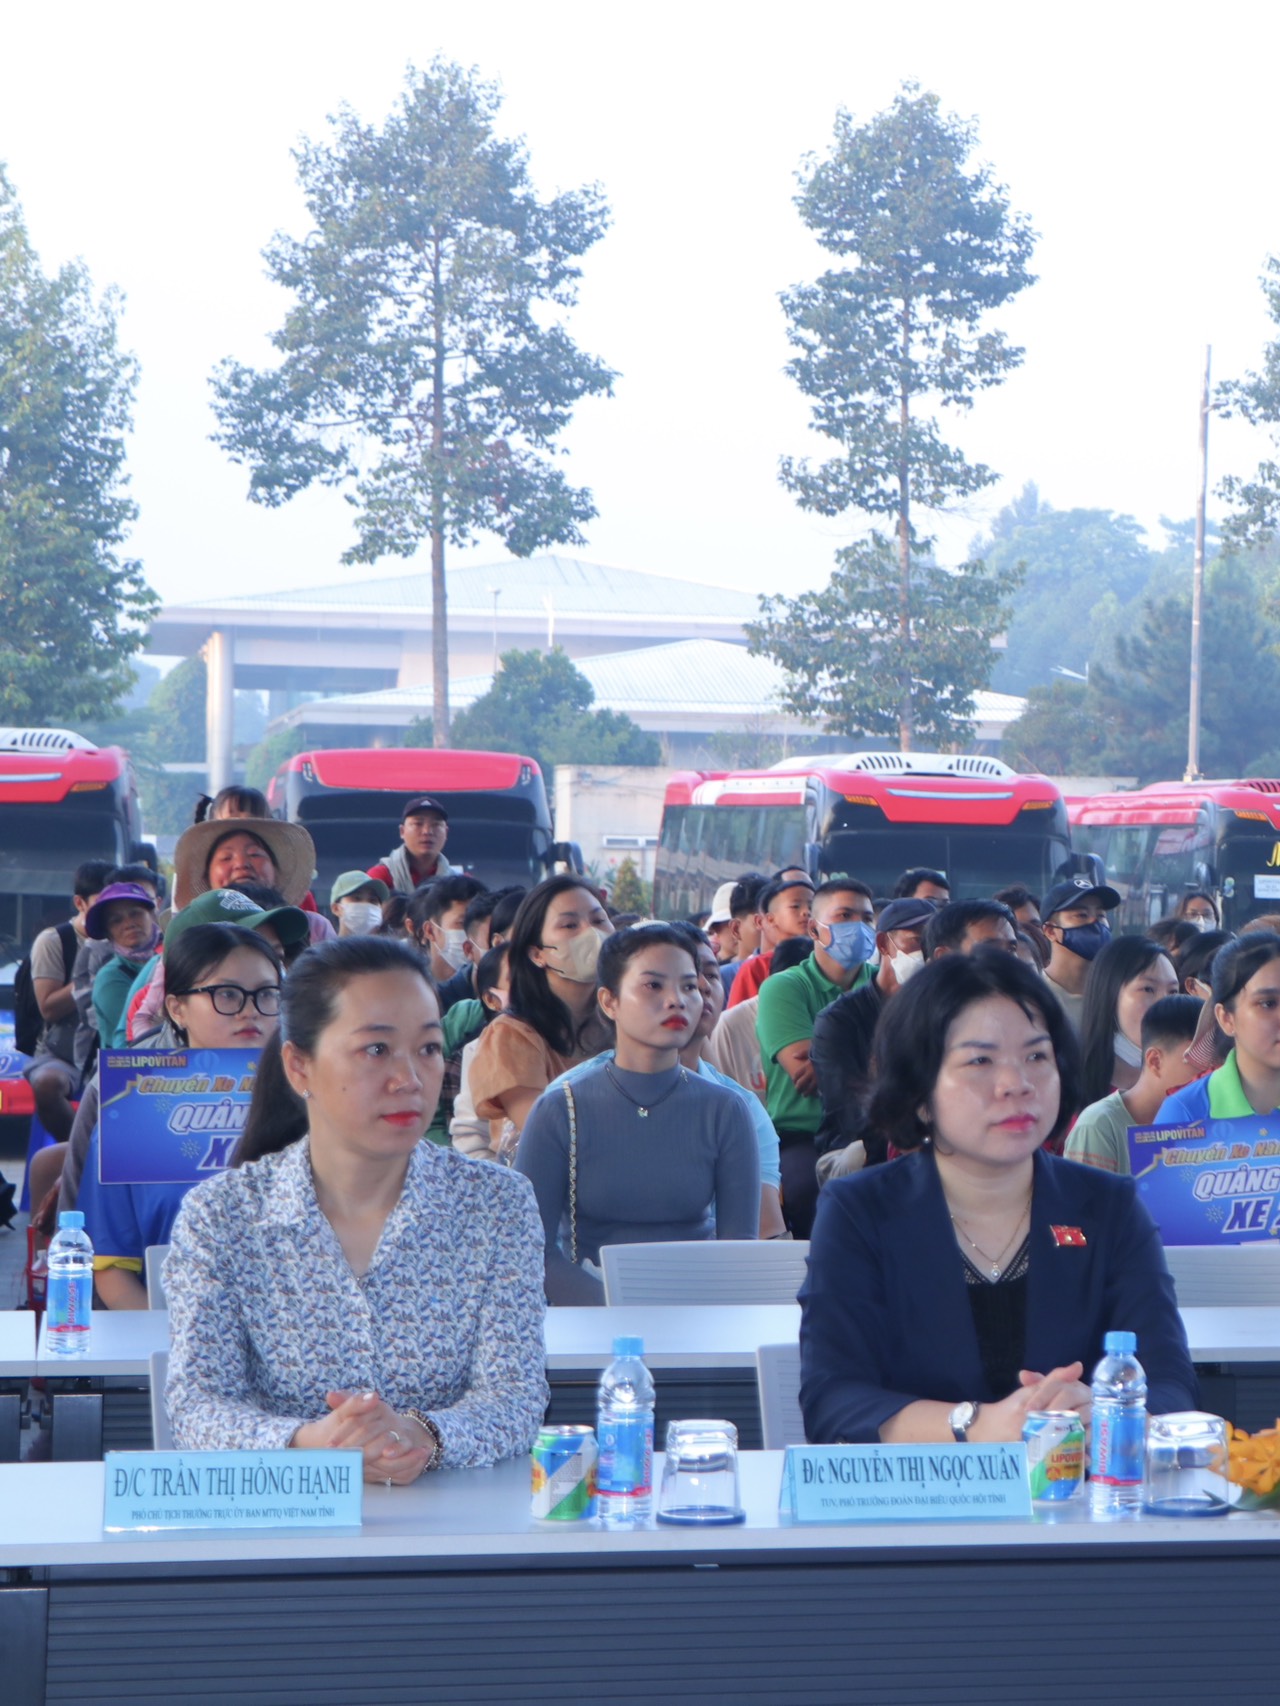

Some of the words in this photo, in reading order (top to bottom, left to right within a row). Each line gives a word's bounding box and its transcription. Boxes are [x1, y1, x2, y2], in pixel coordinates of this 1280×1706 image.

[132, 1056, 187, 1067] LIPOVITAN
[168, 1097, 251, 1134] QUẢN
[1156, 1127, 1205, 1142] LIPOVITAN
[197, 1135, 241, 1169] X
[1164, 1142, 1228, 1166] Chuyến
[1229, 1143, 1251, 1160] Xe
[1222, 1196, 1274, 1233] XE
[114, 1467, 146, 1497] Đ/C
[151, 1459, 201, 1497] TRẦN
[206, 1466, 236, 1502] THỊ
[241, 1457, 293, 1496] HỒNG
[298, 1466, 352, 1501] HẠNH
[828, 1450, 894, 1484] NGUYỄN
[897, 1456, 926, 1488] THỊ
[929, 1456, 976, 1488] NGỌC
[978, 1447, 1020, 1481] XUÂN
[246, 1508, 261, 1518] BAN
[262, 1508, 283, 1519] MTTQ
[301, 1507, 318, 1517] NAM
